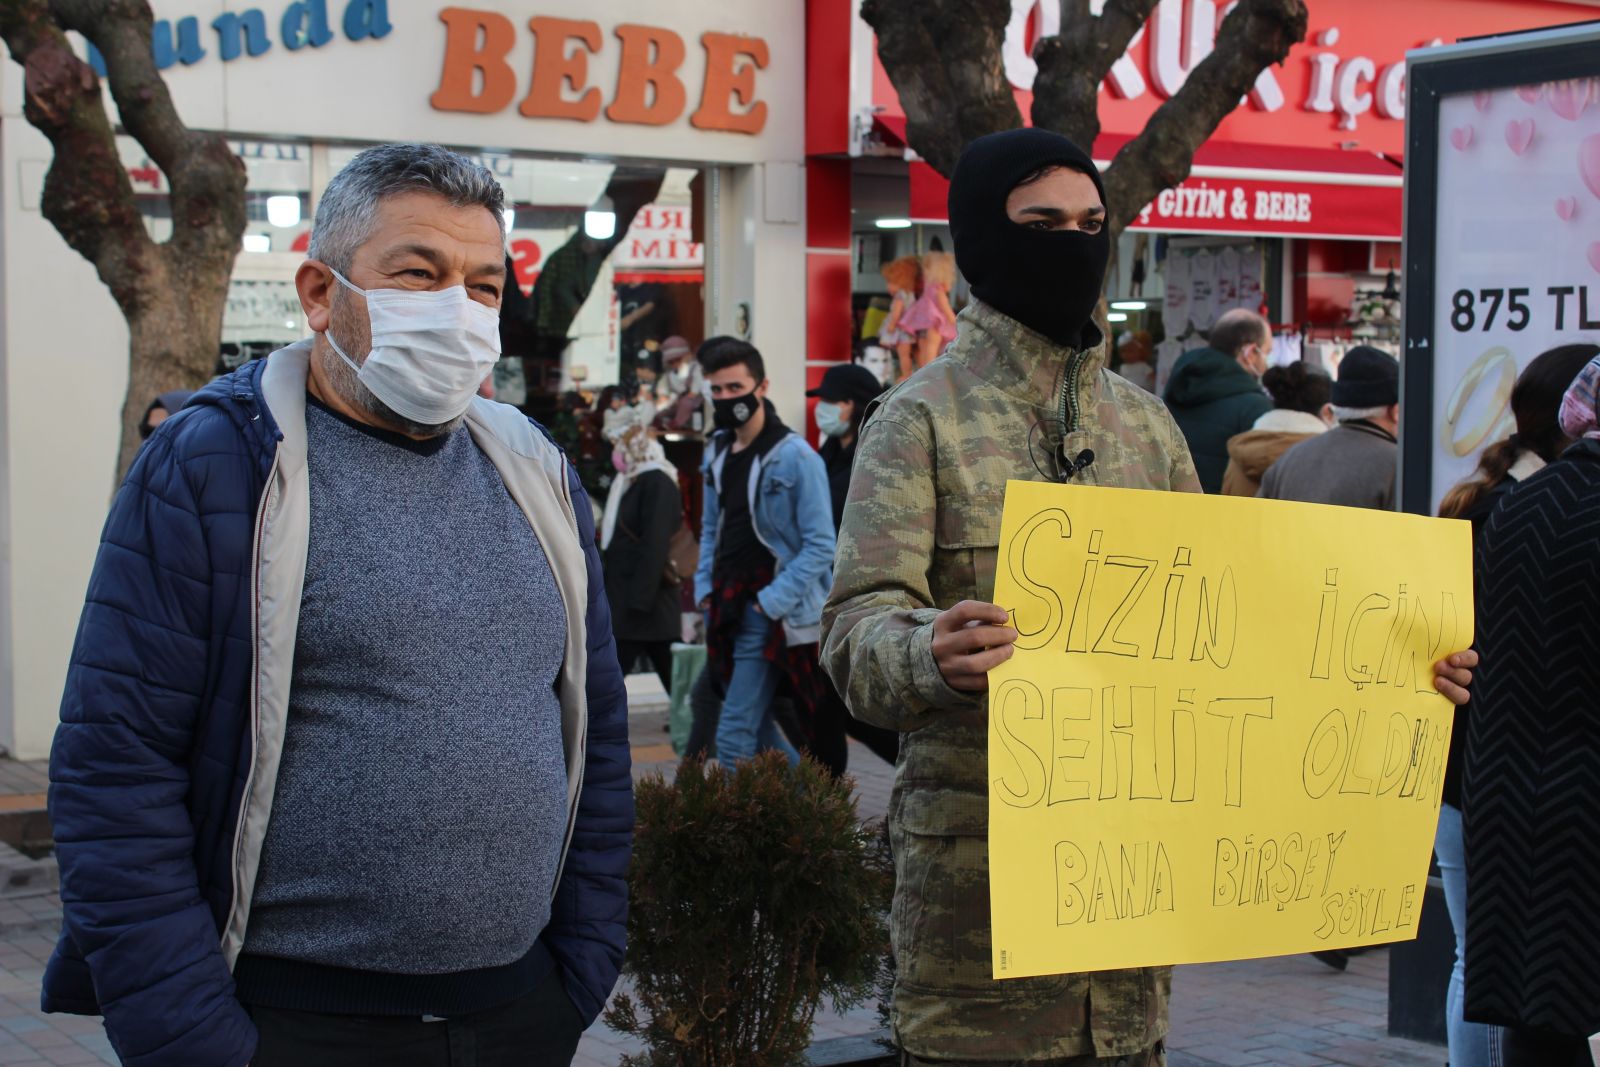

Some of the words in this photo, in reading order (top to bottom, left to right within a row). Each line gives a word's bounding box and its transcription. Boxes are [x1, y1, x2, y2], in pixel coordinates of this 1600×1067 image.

[86, 0, 393, 78] unda
[430, 7, 770, 135] BEBE
[1158, 182, 1227, 218] GİYİM
[1230, 187, 1248, 220] &
[1254, 190, 1312, 222] BEBE
[1451, 288, 1531, 332] 875
[1547, 285, 1600, 330] TL
[1054, 840, 1175, 926] BANA
[1313, 883, 1415, 940] SÖYLE
